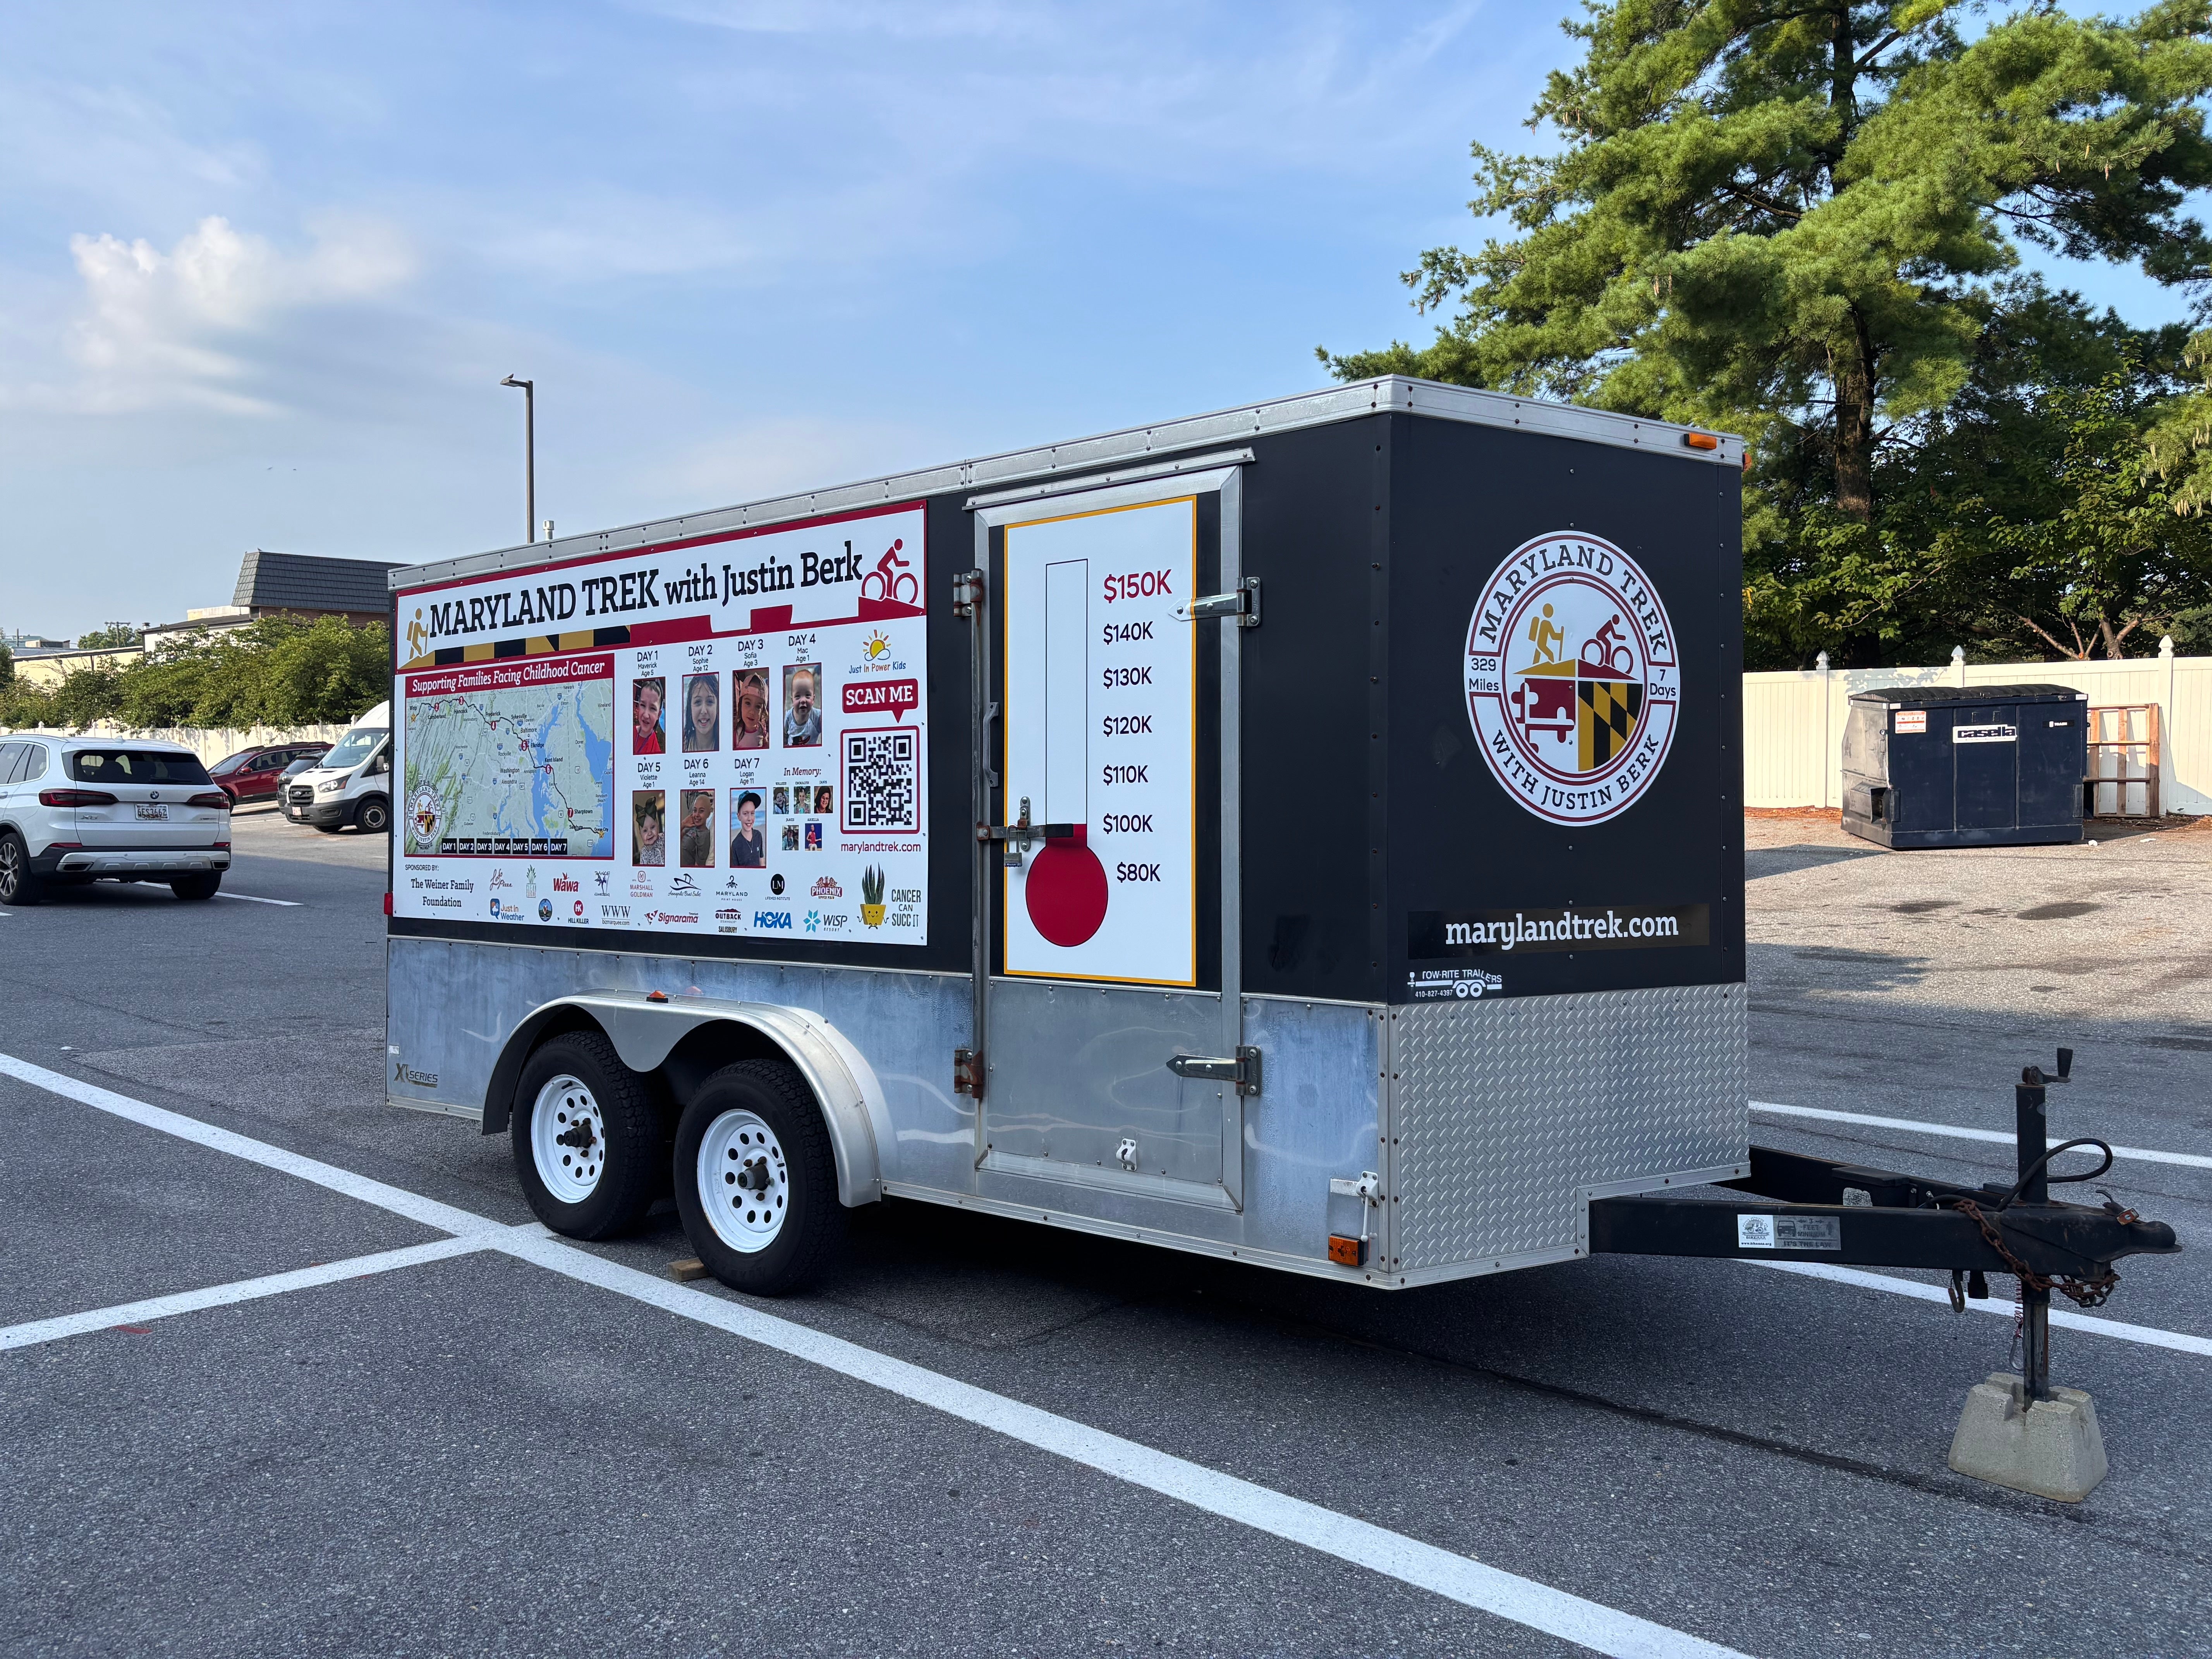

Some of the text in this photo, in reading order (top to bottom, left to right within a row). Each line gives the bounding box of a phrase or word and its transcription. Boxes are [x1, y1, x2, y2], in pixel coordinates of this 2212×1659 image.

[430, 540, 862, 638] MARYLAND TREK with Justin Berk
[1103, 569, 1173, 604] $150K
[1479, 544, 1668, 656] MARYLAND TREK
[788, 634, 816, 647] DAY 4
[1103, 621, 1153, 646] $140K
[688, 645, 713, 656] DAY 2
[738, 639, 764, 651] DAY 3
[637, 651, 658, 662] DAY 1
[849, 661, 906, 674] Just In Power Kids
[1471, 658, 1496, 672] 329
[412, 661, 605, 694] Supporting Families Facing Childhood Cancer
[1103, 666, 1152, 689] $130K
[1659, 669, 1665, 682] 7
[1468, 678, 1499, 692] Miles
[1650, 683, 1676, 700] Days
[846, 685, 913, 706] SCAN ME
[1103, 715, 1152, 737] $120K
[1958, 726, 2015, 738] casella
[638, 762, 661, 773] DAY 5
[684, 759, 709, 769] DAY 6
[735, 758, 760, 769] DAY 7
[1492, 729, 1659, 810] WITH JUSTIN BERK
[783, 767, 821, 777] In Memory:
[1103, 764, 1148, 786] $110K
[1103, 813, 1153, 835] $100K
[543, 843, 548, 851] 6
[841, 841, 921, 854] marylandtrek.com
[1117, 862, 1161, 883] $80K
[411, 878, 474, 893] The Weiner Family
[553, 878, 579, 892] Wawa
[812, 887, 841, 896] PHOENIX
[422, 896, 462, 907] Foundation
[891, 889, 921, 903] CANCER
[575, 904, 582, 912] HK
[601, 905, 630, 918] WWW
[501, 912, 524, 921] Weather
[658, 912, 698, 924] Signarama
[754, 911, 792, 929] HOKA
[892, 913, 919, 927] SUCC IT
[1446, 910, 1679, 950] marylandtrek.com
[1422, 969, 1502, 983] TOW-RITE TRAILERS
[1415, 989, 1453, 998] 410-827-4397
[409, 1070, 438, 1083] SERIES
